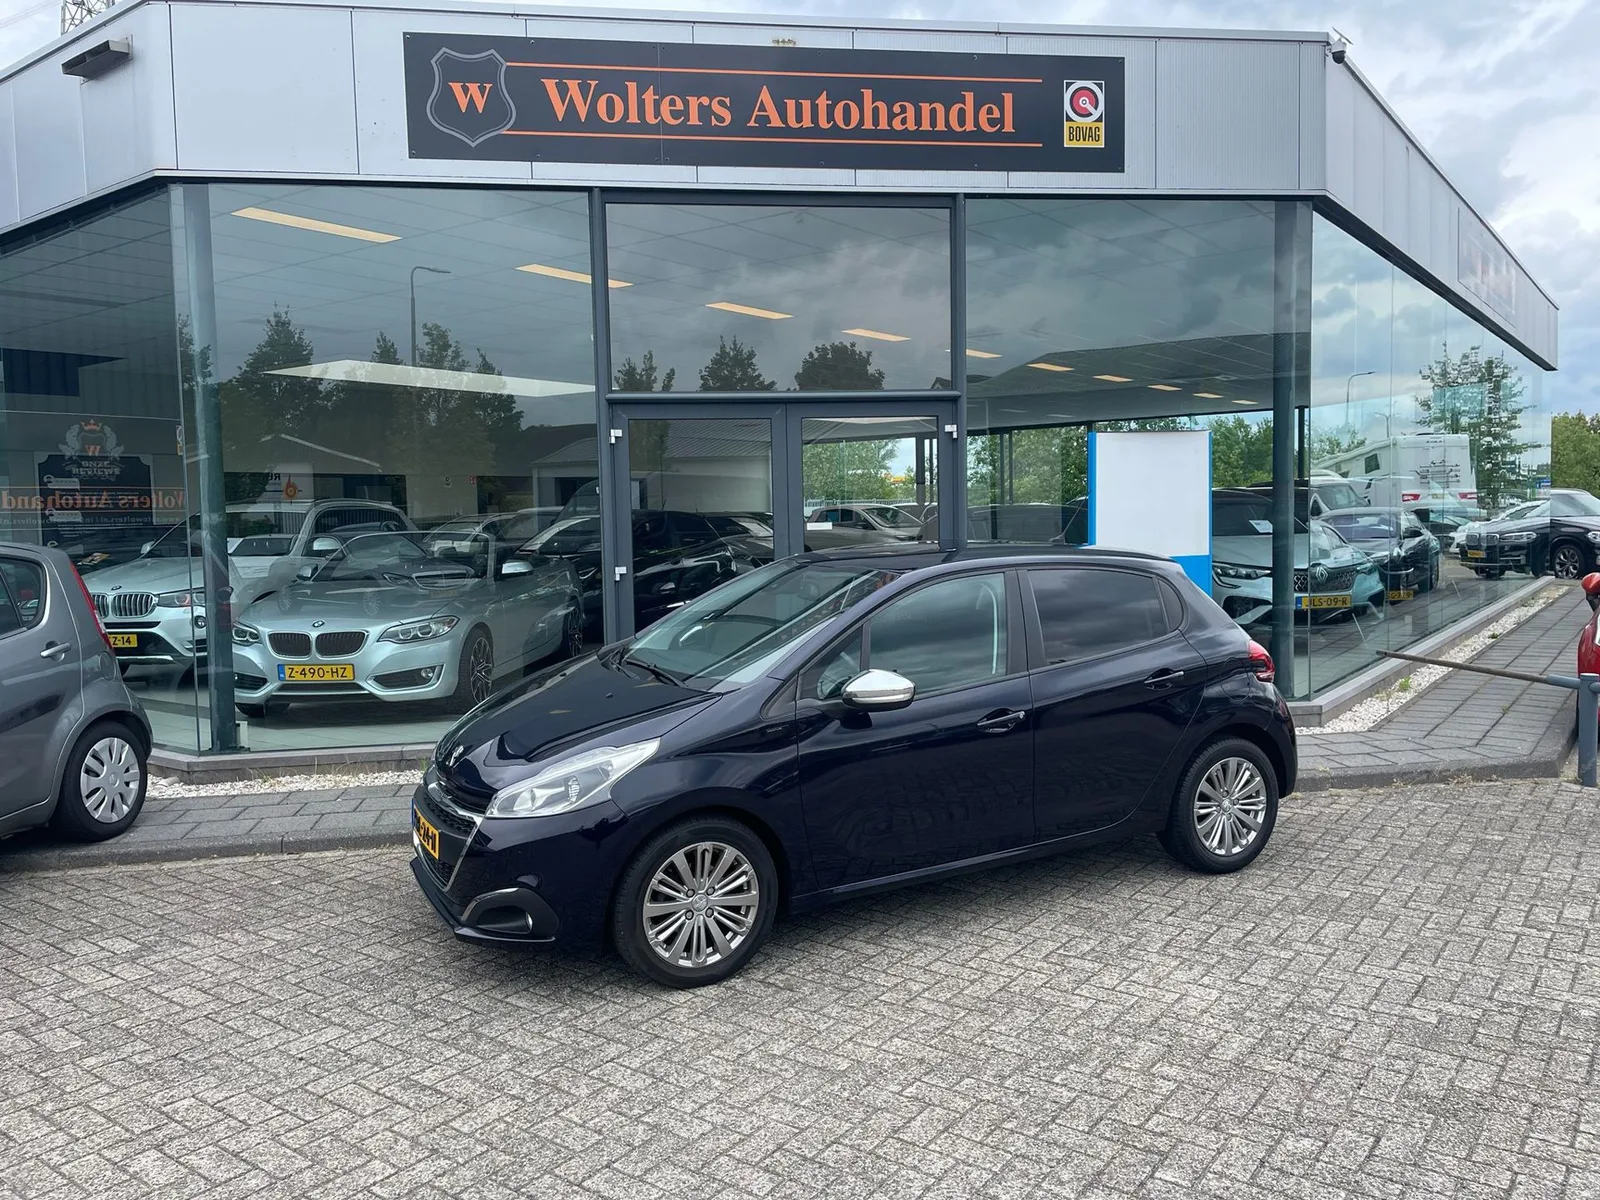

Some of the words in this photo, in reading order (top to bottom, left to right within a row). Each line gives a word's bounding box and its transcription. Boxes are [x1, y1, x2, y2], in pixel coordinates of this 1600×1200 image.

[448, 82, 493, 114] W
[540, 78, 732, 127] Wolters
[746, 85, 1016, 133] Autohandel
[1068, 126, 1100, 142] BOVAG
[288, 667, 348, 678] Z-490-HZ
